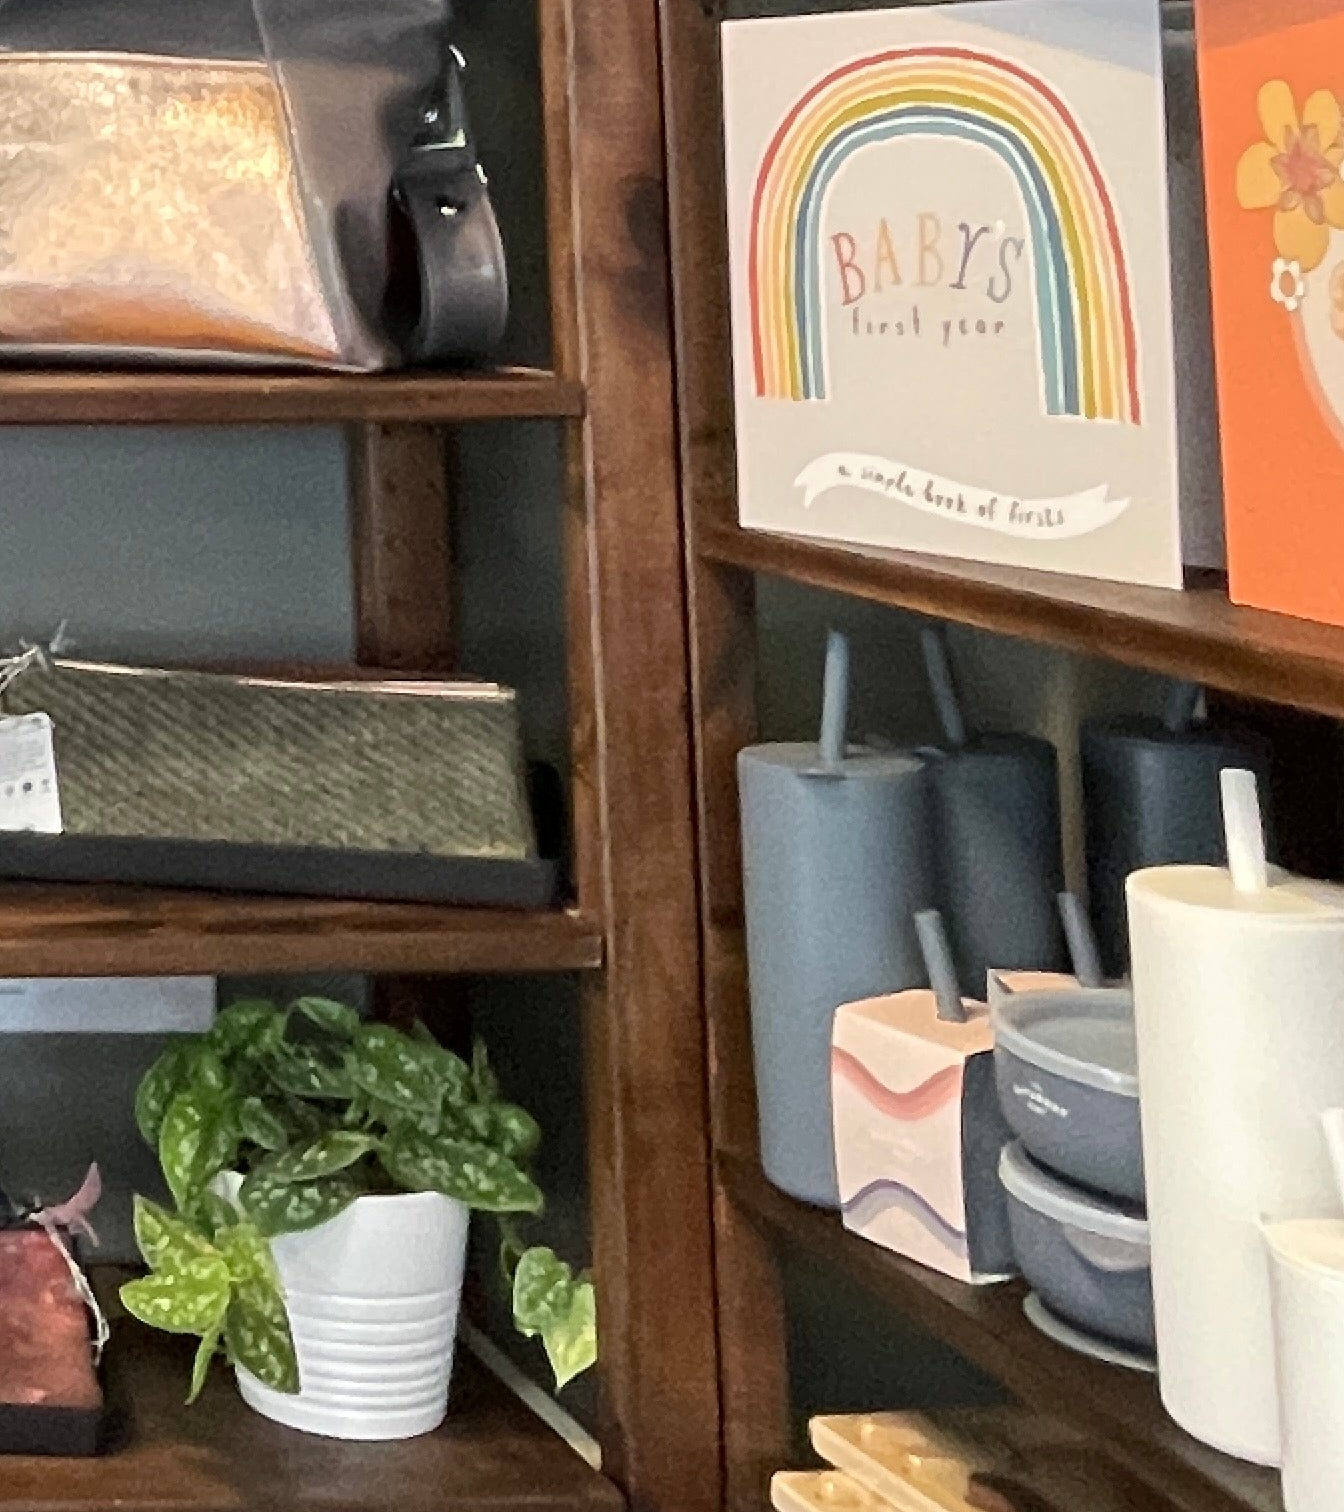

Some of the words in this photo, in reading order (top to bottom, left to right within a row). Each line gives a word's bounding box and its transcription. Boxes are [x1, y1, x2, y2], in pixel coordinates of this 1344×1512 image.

[830, 211, 1026, 305] BABY'S
[852, 305, 920, 335] first
[942, 317, 1004, 347] year
[860, 466, 914, 497] simple
[924, 479, 967, 514] book
[977, 496, 998, 521] of
[1008, 500, 1065, 527] firsts
